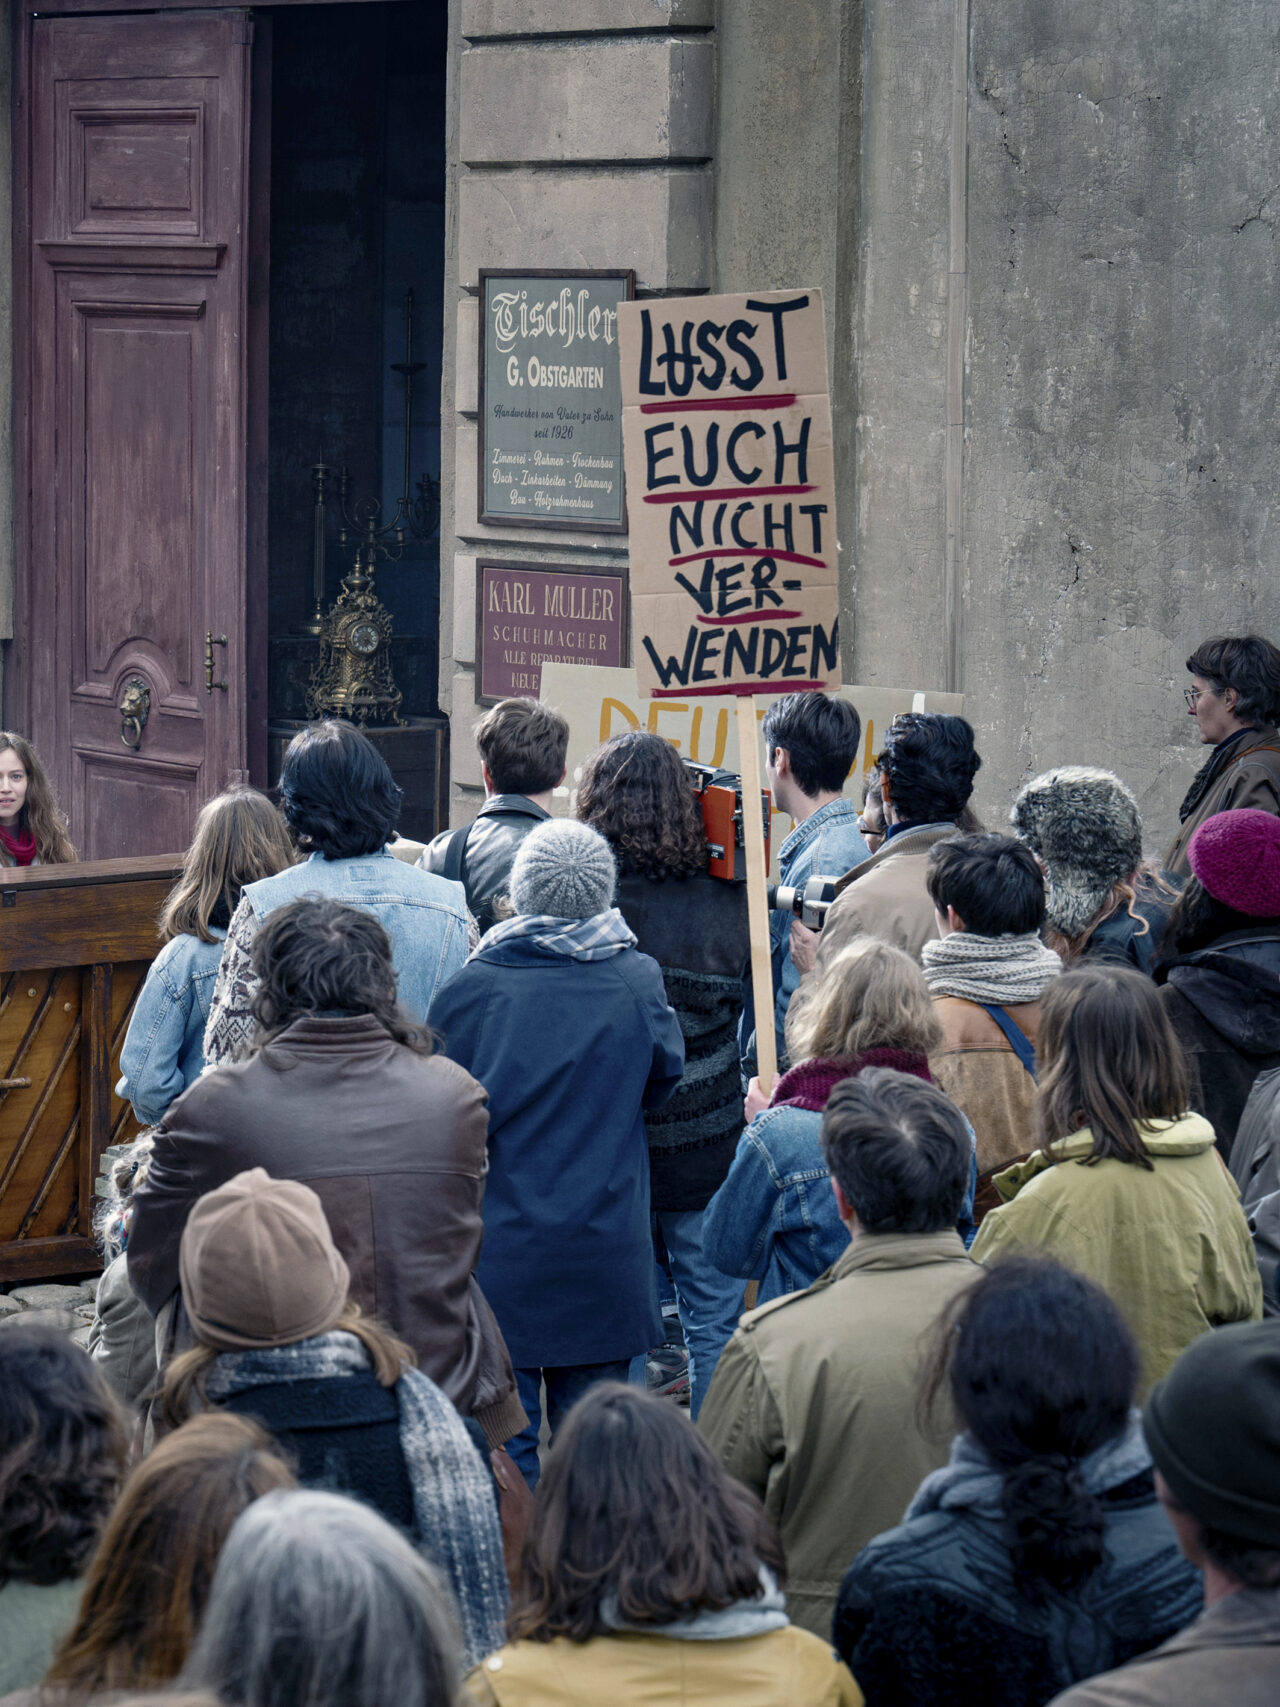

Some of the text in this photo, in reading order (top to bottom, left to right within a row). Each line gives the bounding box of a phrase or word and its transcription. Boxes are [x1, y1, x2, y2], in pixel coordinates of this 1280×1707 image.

[491, 287, 618, 353] Tischler
[507, 355, 524, 387] G.
[534, 425, 574, 440] seit 1926
[492, 448, 527, 466] Zimmerei
[572, 452, 614, 469] Trockenbau
[644, 416, 812, 491] EUCH
[492, 468, 513, 485] Dach
[510, 489, 527, 506] Bau
[670, 500, 828, 555] NICHT
[488, 580, 536, 616] KARL
[674, 556, 803, 617] VER-
[493, 624, 607, 651] SCHUHMACHER
[642, 616, 839, 688] WENDEN
[503, 650, 527, 665] ALLE
[511, 672, 539, 690] NEUE
